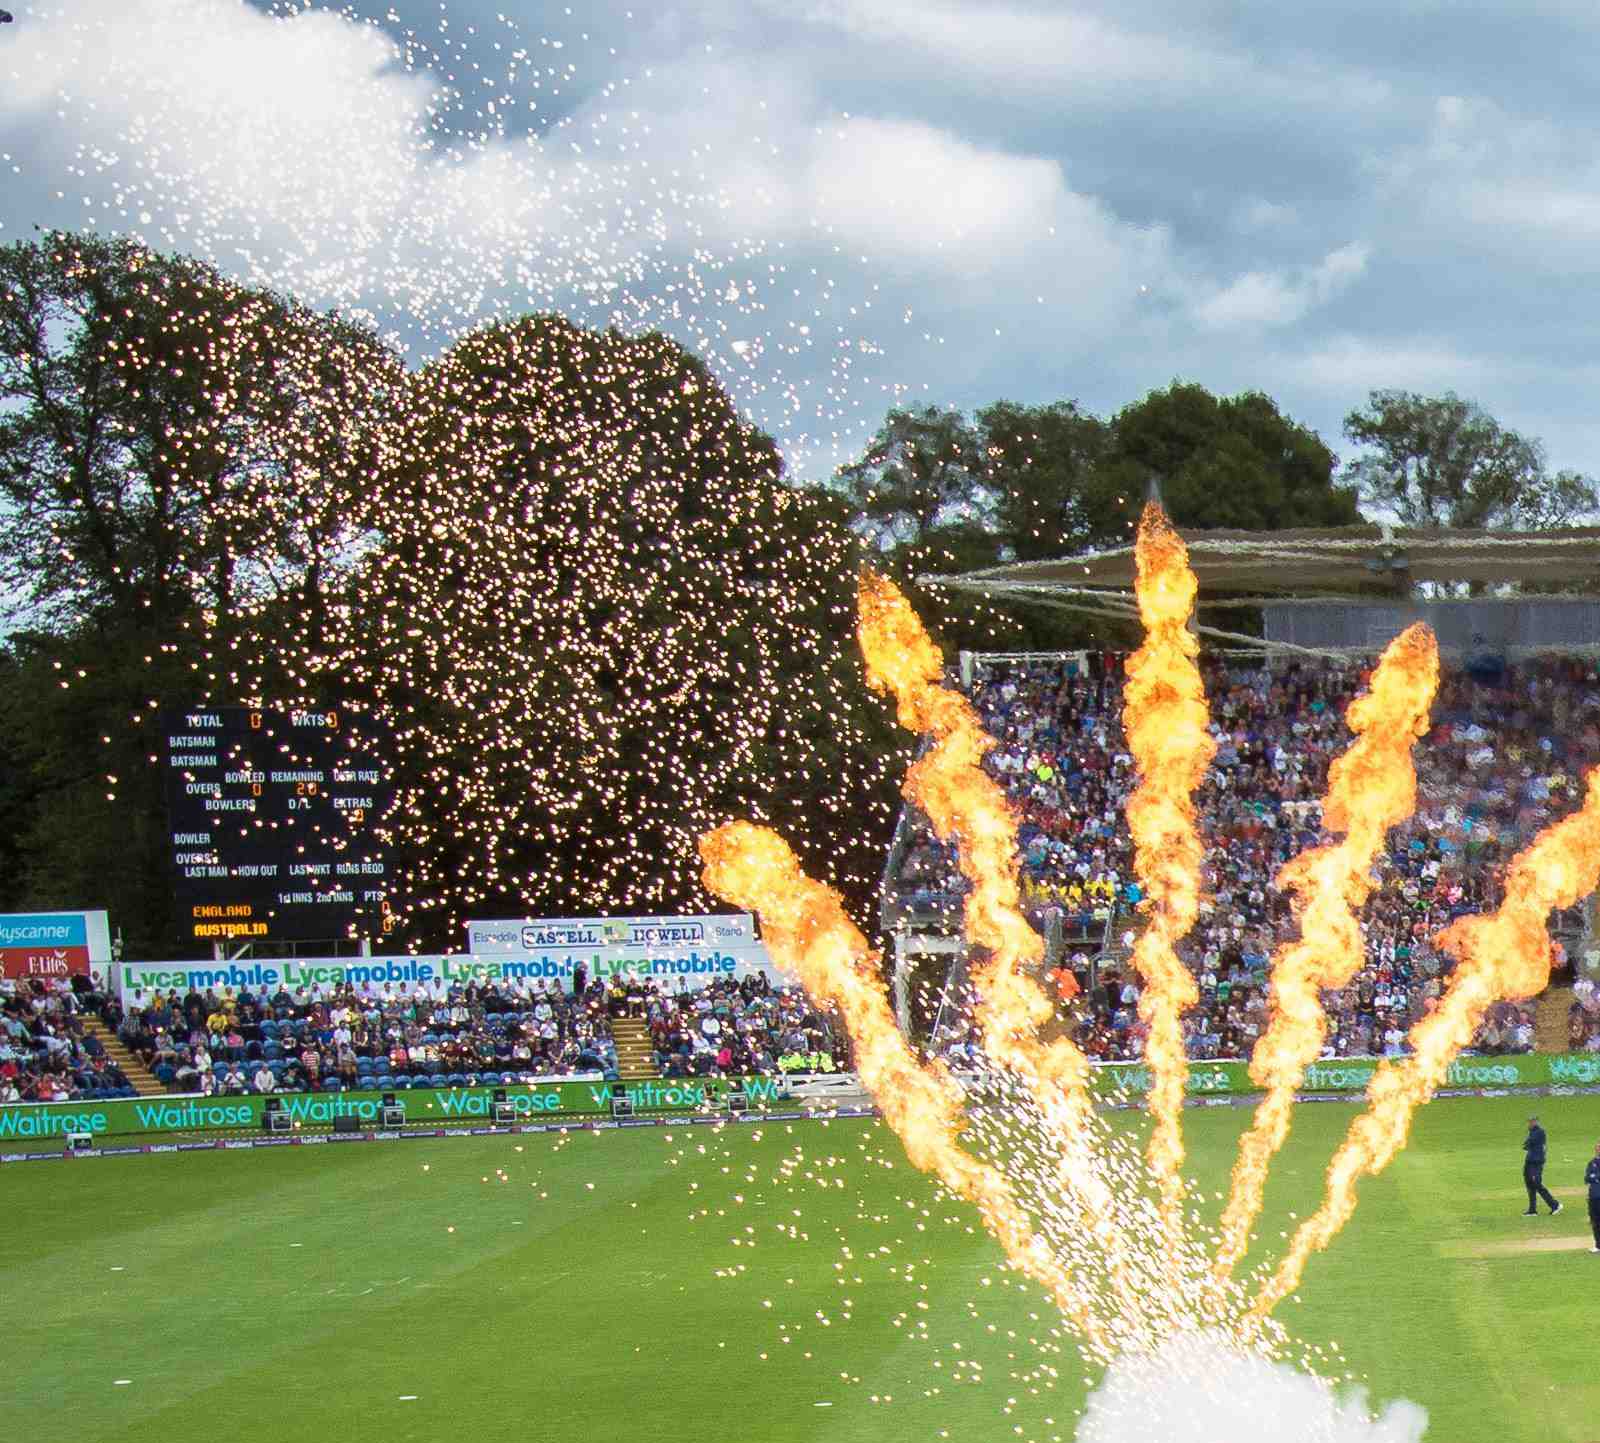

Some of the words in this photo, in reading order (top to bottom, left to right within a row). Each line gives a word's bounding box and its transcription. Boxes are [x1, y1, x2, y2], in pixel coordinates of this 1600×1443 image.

[186, 714, 224, 727] TOTAL
[291, 713, 325, 727] WKTS
[169, 736, 216, 748] BATSMAN
[171, 755, 217, 767] BATSMAN
[225, 771, 265, 783] BOWLED
[271, 771, 324, 782] REMAINING
[186, 783, 221, 794] OVERS
[205, 799, 256, 811] BOWLERS
[333, 798, 374, 809] EXTRAS
[174, 833, 211, 844] BOWLER
[185, 867, 207, 878] LAST
[208, 867, 228, 877] MAN
[238, 865, 259, 876] HOW
[260, 865, 278, 875] OUT
[193, 904, 252, 917] ENGLAND
[0, 924, 71, 943] kyscanner
[194, 923, 268, 936] AUSTRALIA
[125, 964, 278, 990] Lycamobile
[283, 960, 434, 989] Lycamobile
[594, 951, 737, 978] Lycamobile
[435, 1089, 560, 1116] Wairose
[136, 1102, 253, 1129] Waitrose
[0, 1108, 107, 1137] Waitrose
